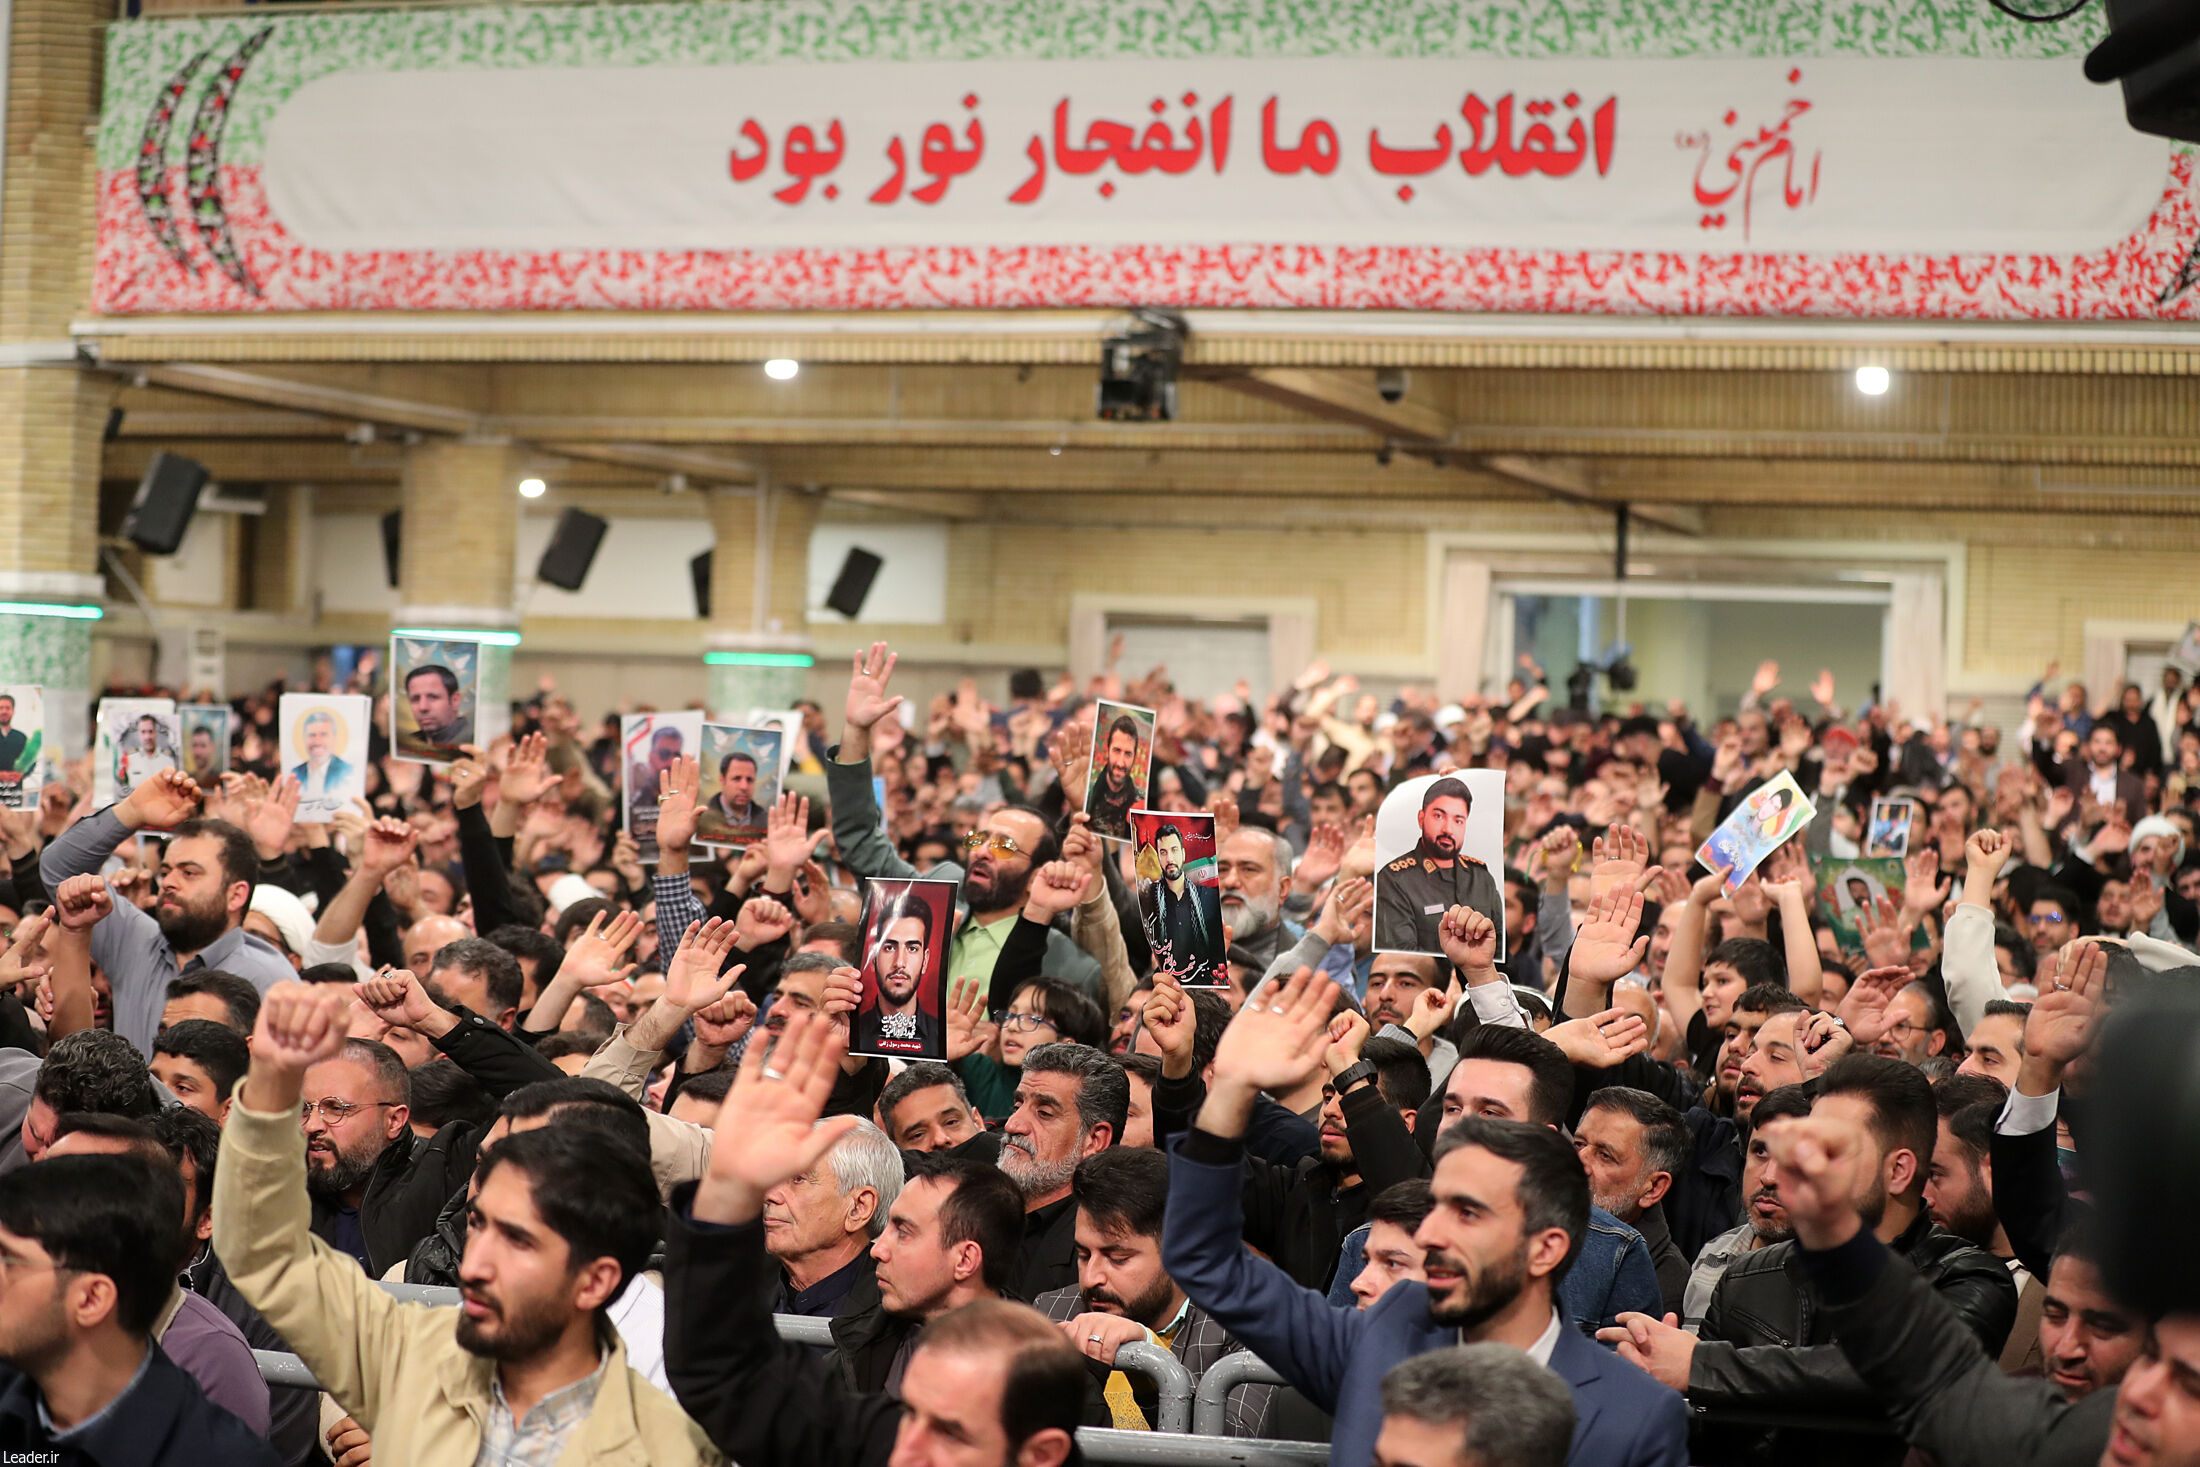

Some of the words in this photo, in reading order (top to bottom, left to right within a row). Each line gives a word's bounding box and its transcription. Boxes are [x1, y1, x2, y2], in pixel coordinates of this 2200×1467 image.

[729, 118, 847, 205] بود
[869, 93, 985, 205] نور
[1007, 91, 1233, 204] انفجار
[1261, 96, 1341, 177] ما
[1368, 92, 1617, 202] انقلاب
[1693, 68, 1813, 230] خمینی
[1743, 137, 1821, 243] امام
